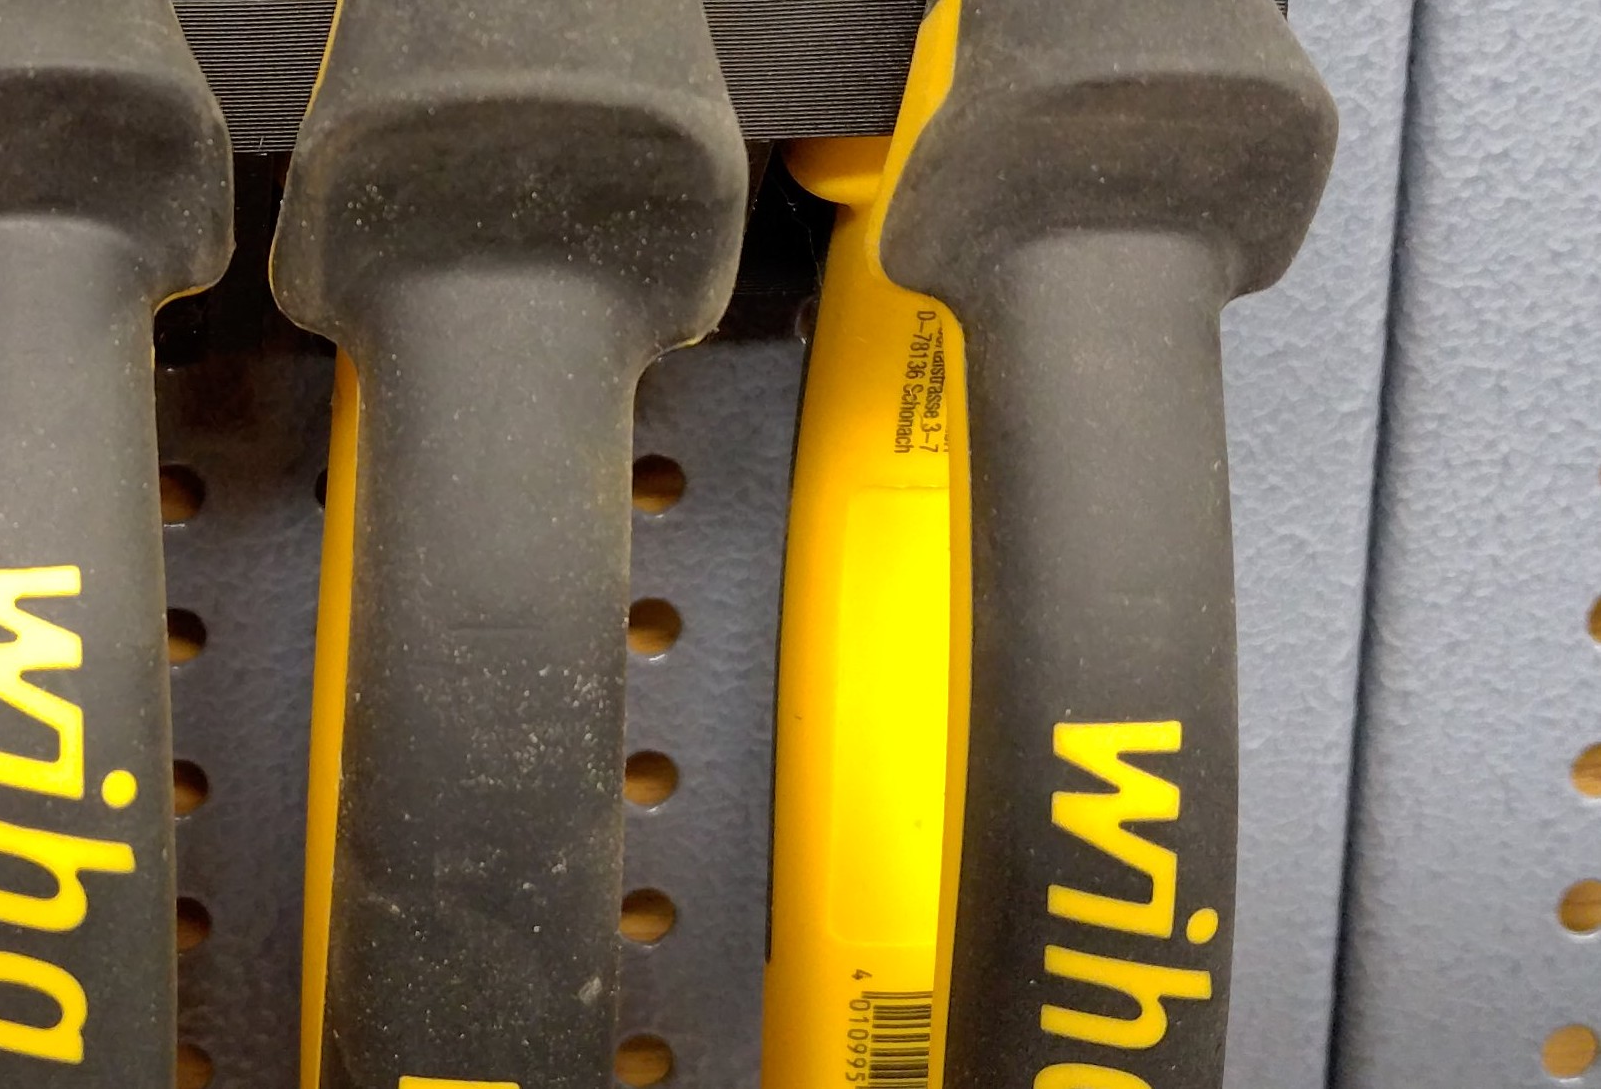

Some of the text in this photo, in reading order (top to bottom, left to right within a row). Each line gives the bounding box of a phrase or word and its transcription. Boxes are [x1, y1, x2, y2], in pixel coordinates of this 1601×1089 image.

[923, 327, 946, 419] talstrasse
[894, 384, 924, 453] Schonach
[1032, 720, 1219, 1089] wih
[845, 999, 871, 1082] 010995
